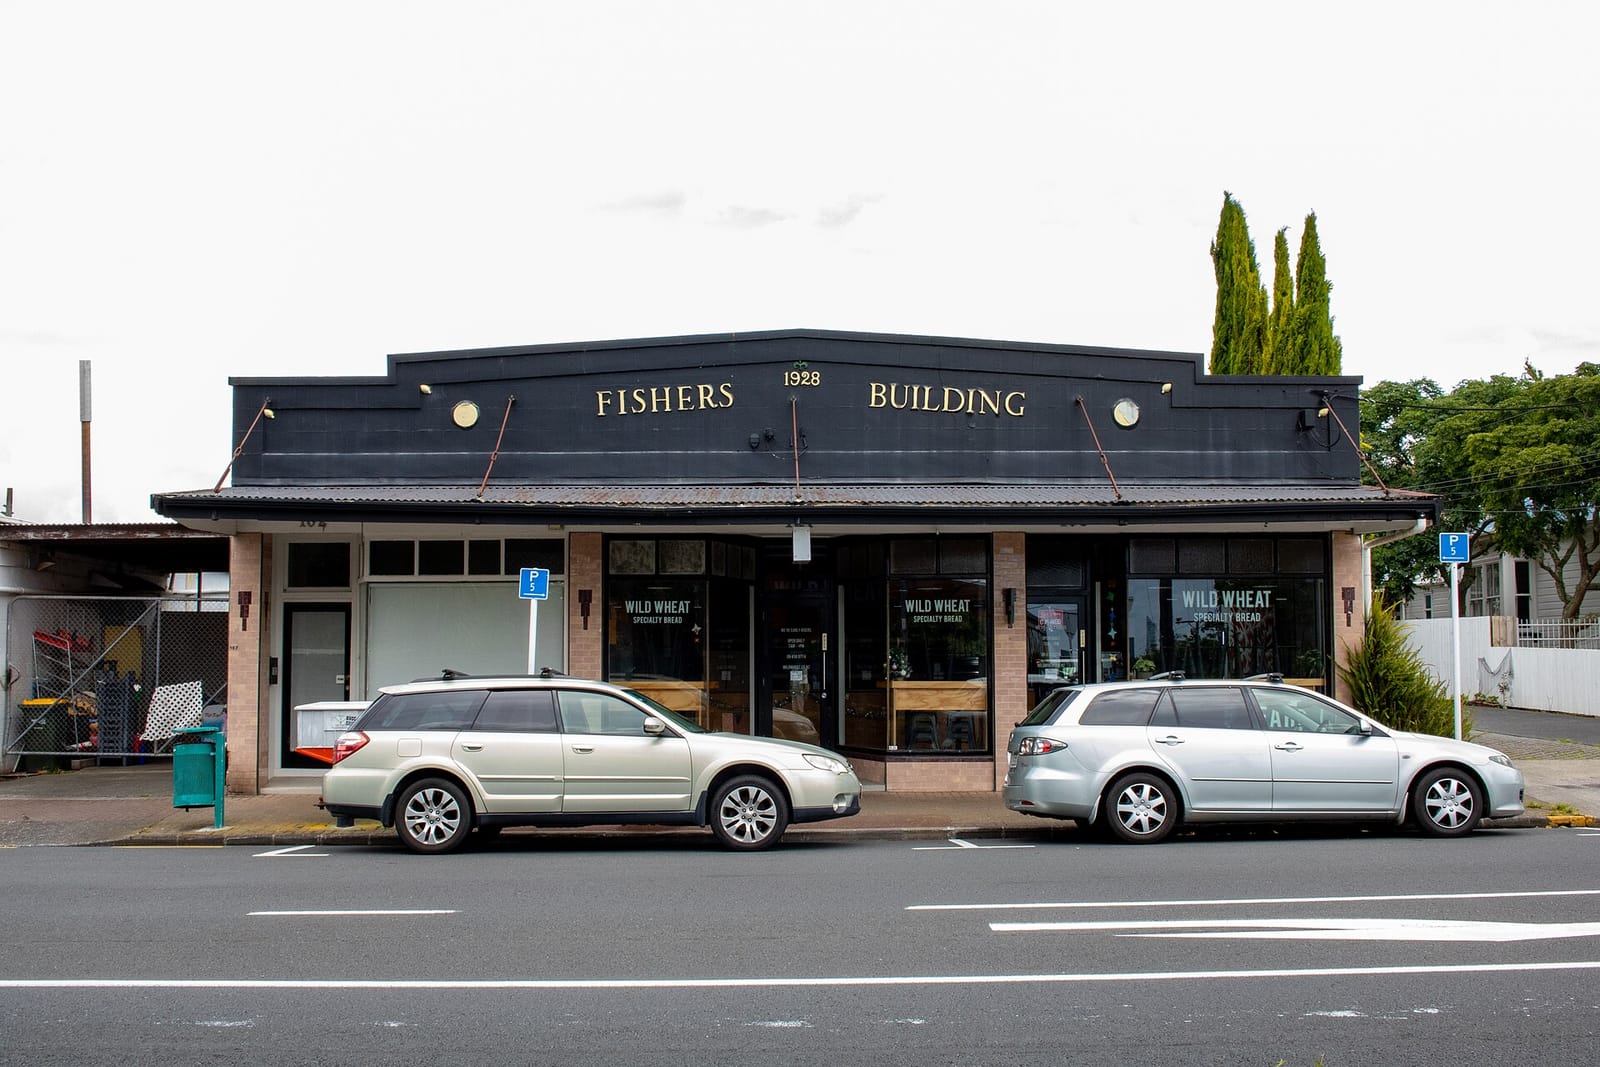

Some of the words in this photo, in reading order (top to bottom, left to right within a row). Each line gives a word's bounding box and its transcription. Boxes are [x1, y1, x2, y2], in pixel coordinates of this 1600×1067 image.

[784, 371, 820, 386] 1928
[596, 383, 734, 416] FISHERS
[869, 382, 1026, 417] BUILDING
[1449, 535, 1459, 546] P
[1450, 546, 1457, 556] 5
[529, 570, 539, 582] P
[529, 582, 536, 592] 5
[1182, 590, 1218, 608] WILD
[1222, 590, 1272, 608] WHEAT
[625, 600, 652, 614] WILD
[654, 600, 691, 614] WHEAT
[905, 599, 931, 613] WILD
[934, 599, 971, 613] WHEAT
[633, 616, 662, 624] SPECIALTY
[663, 616, 683, 624] BREAD
[913, 615, 943, 623] SPECIALTY
[944, 615, 963, 623] BREAD
[1193, 612, 1233, 622] SPECIALTY
[1235, 612, 1261, 622] BREAD
